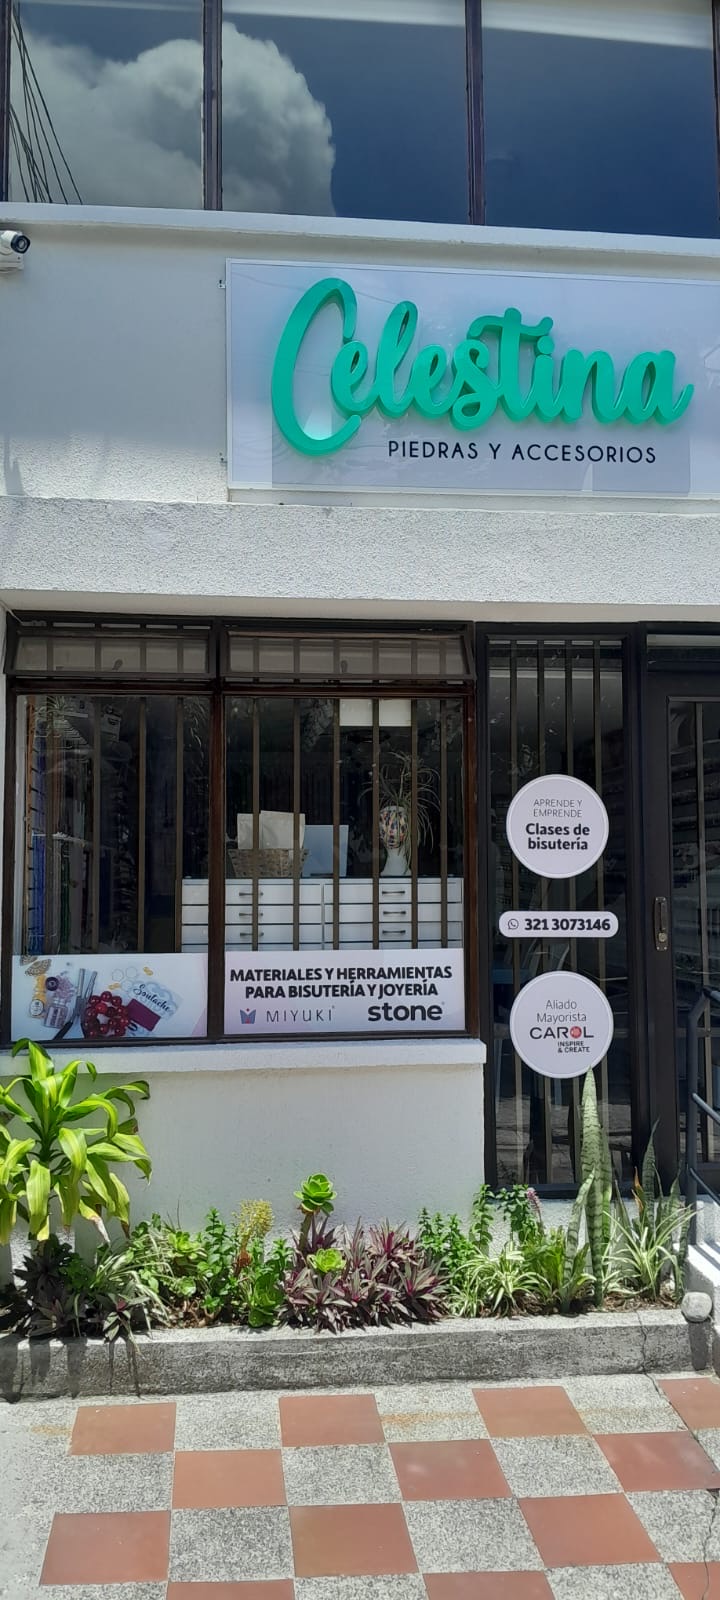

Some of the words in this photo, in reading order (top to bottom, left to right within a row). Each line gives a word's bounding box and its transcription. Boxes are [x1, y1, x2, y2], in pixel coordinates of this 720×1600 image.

[271, 277, 695, 456] Celestina
[388, 440, 479, 461] PIEDRAS
[488, 443, 502, 461] Y
[511, 444, 657, 464] ACCESORIOS
[533, 798, 575, 808] APRENDE
[577, 800, 583, 808] Y
[533, 809, 583, 818] EMPRENDE
[525, 822, 570, 836] Clases
[573, 823, 591, 836] de
[527, 837, 588, 850] bisutería
[524, 918, 549, 931] 321
[551, 919, 611, 931] 3073146
[230, 968, 322, 982] MATERIALES
[324, 967, 334, 980] Y
[336, 966, 452, 980] HERRAMIENTAS
[245, 985, 286, 999] PARA
[288, 981, 363, 998] BISUTERÍA
[366, 984, 377, 997] Y
[378, 979, 438, 999] JOYERÍA
[545, 999, 577, 1010] Aliado
[266, 1009, 332, 1023] MIYUKI
[367, 1002, 443, 1022] stone
[536, 1012, 587, 1025] Mayorista
[529, 1026, 594, 1039] CAROL
